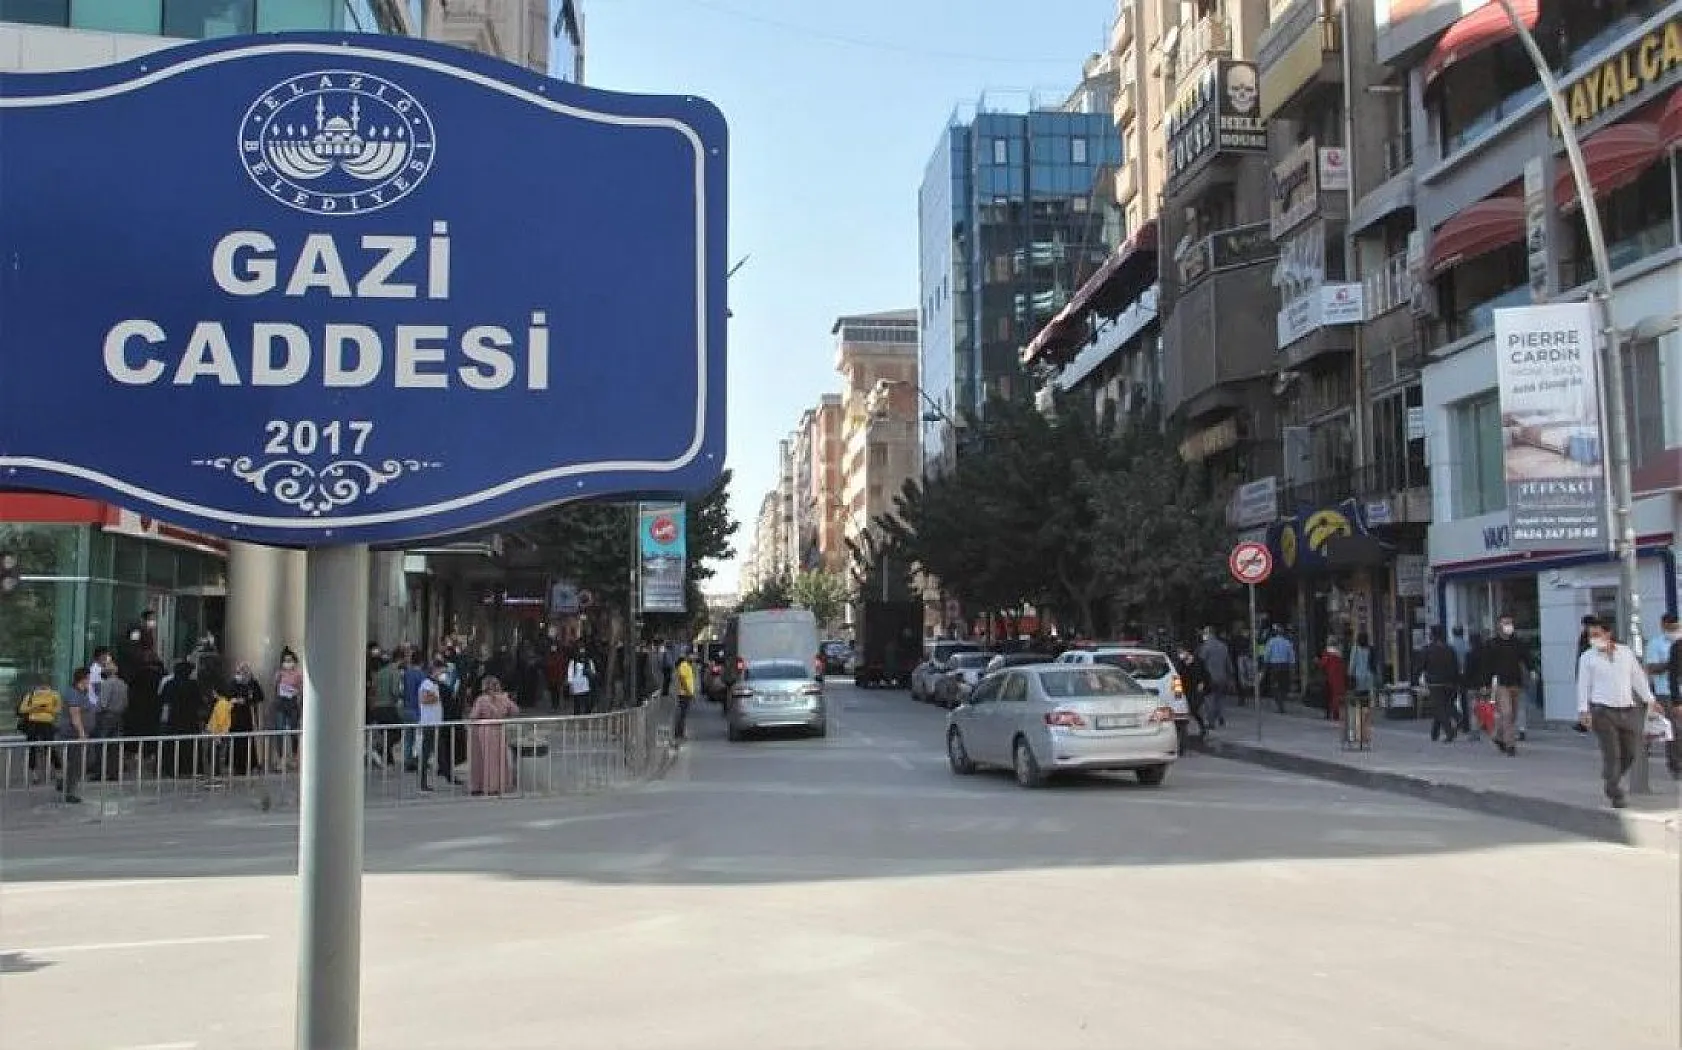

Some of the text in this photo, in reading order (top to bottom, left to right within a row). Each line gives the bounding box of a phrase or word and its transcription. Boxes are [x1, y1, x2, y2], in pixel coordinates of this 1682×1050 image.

[212, 220, 450, 299] GAZİ
[103, 311, 549, 390] CADDESİ
[264, 420, 373, 455] 2017
